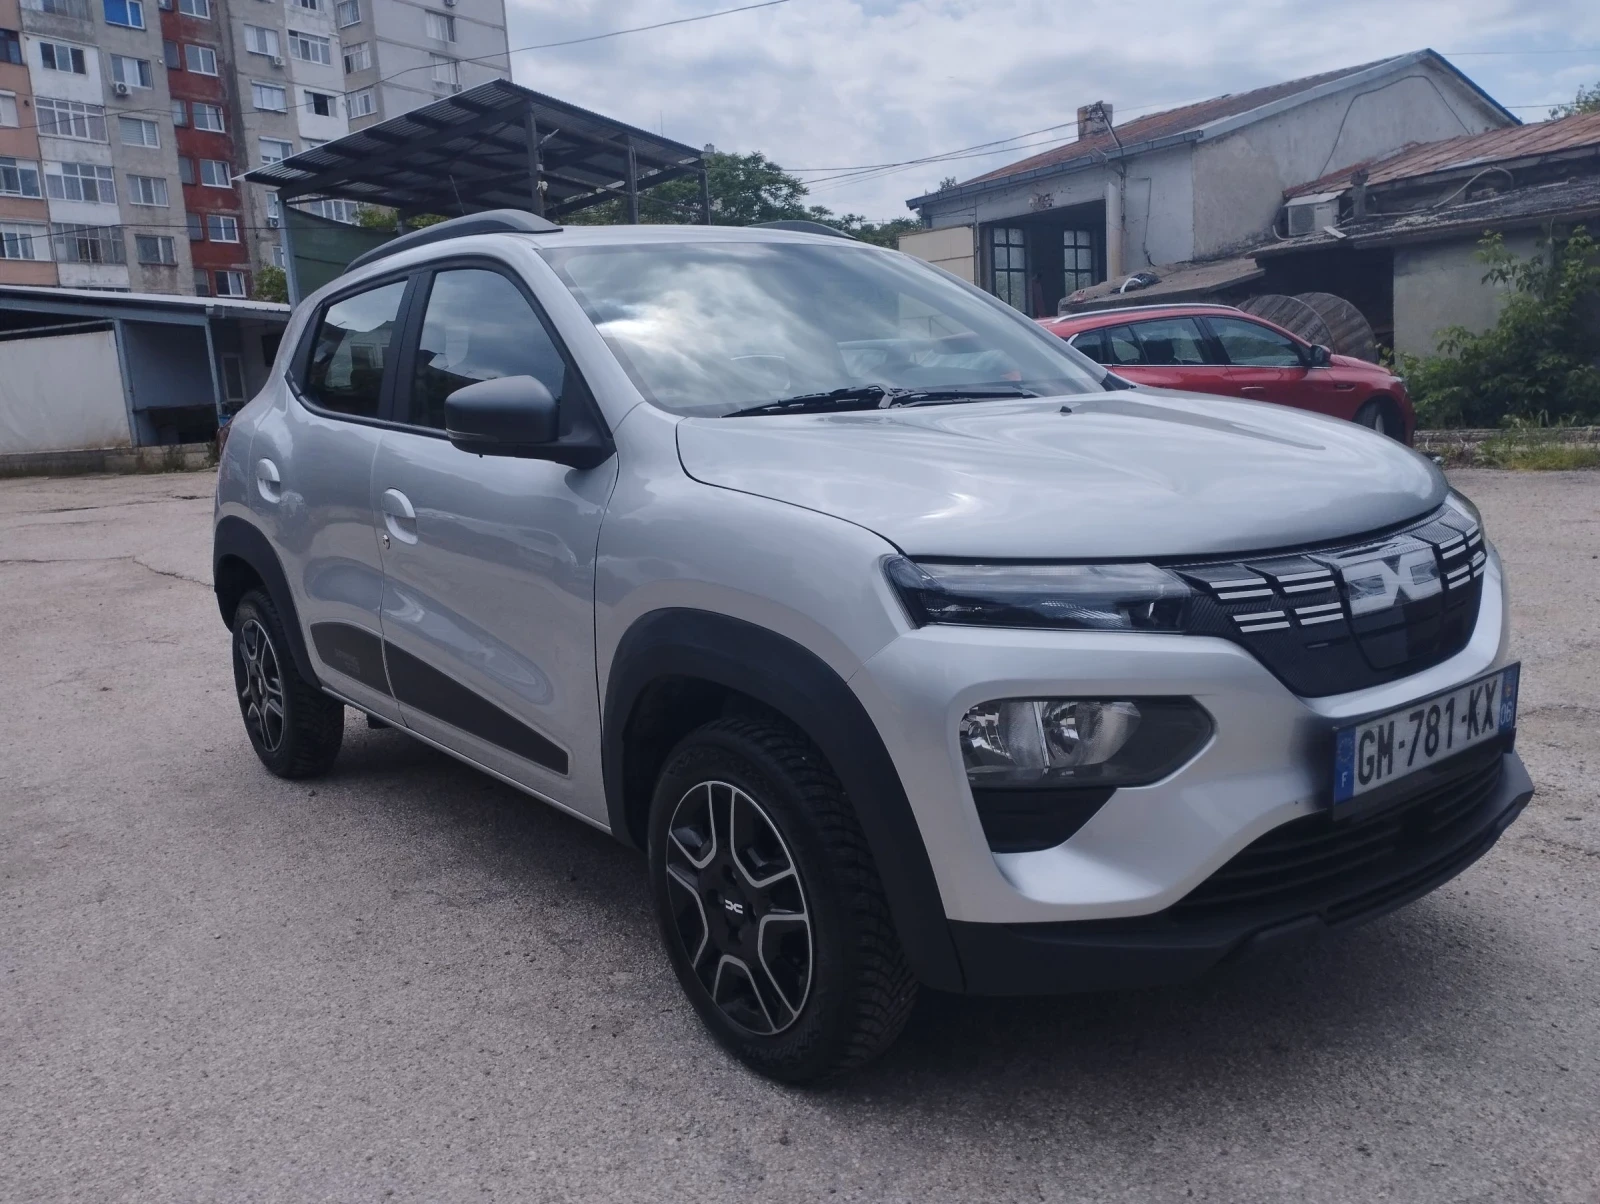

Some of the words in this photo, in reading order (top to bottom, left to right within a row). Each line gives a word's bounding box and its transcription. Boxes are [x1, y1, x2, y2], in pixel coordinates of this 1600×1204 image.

[1500, 701, 1513, 725] 06
[1357, 679, 1498, 786] GM-781-KX
[1341, 771, 1349, 788] F
